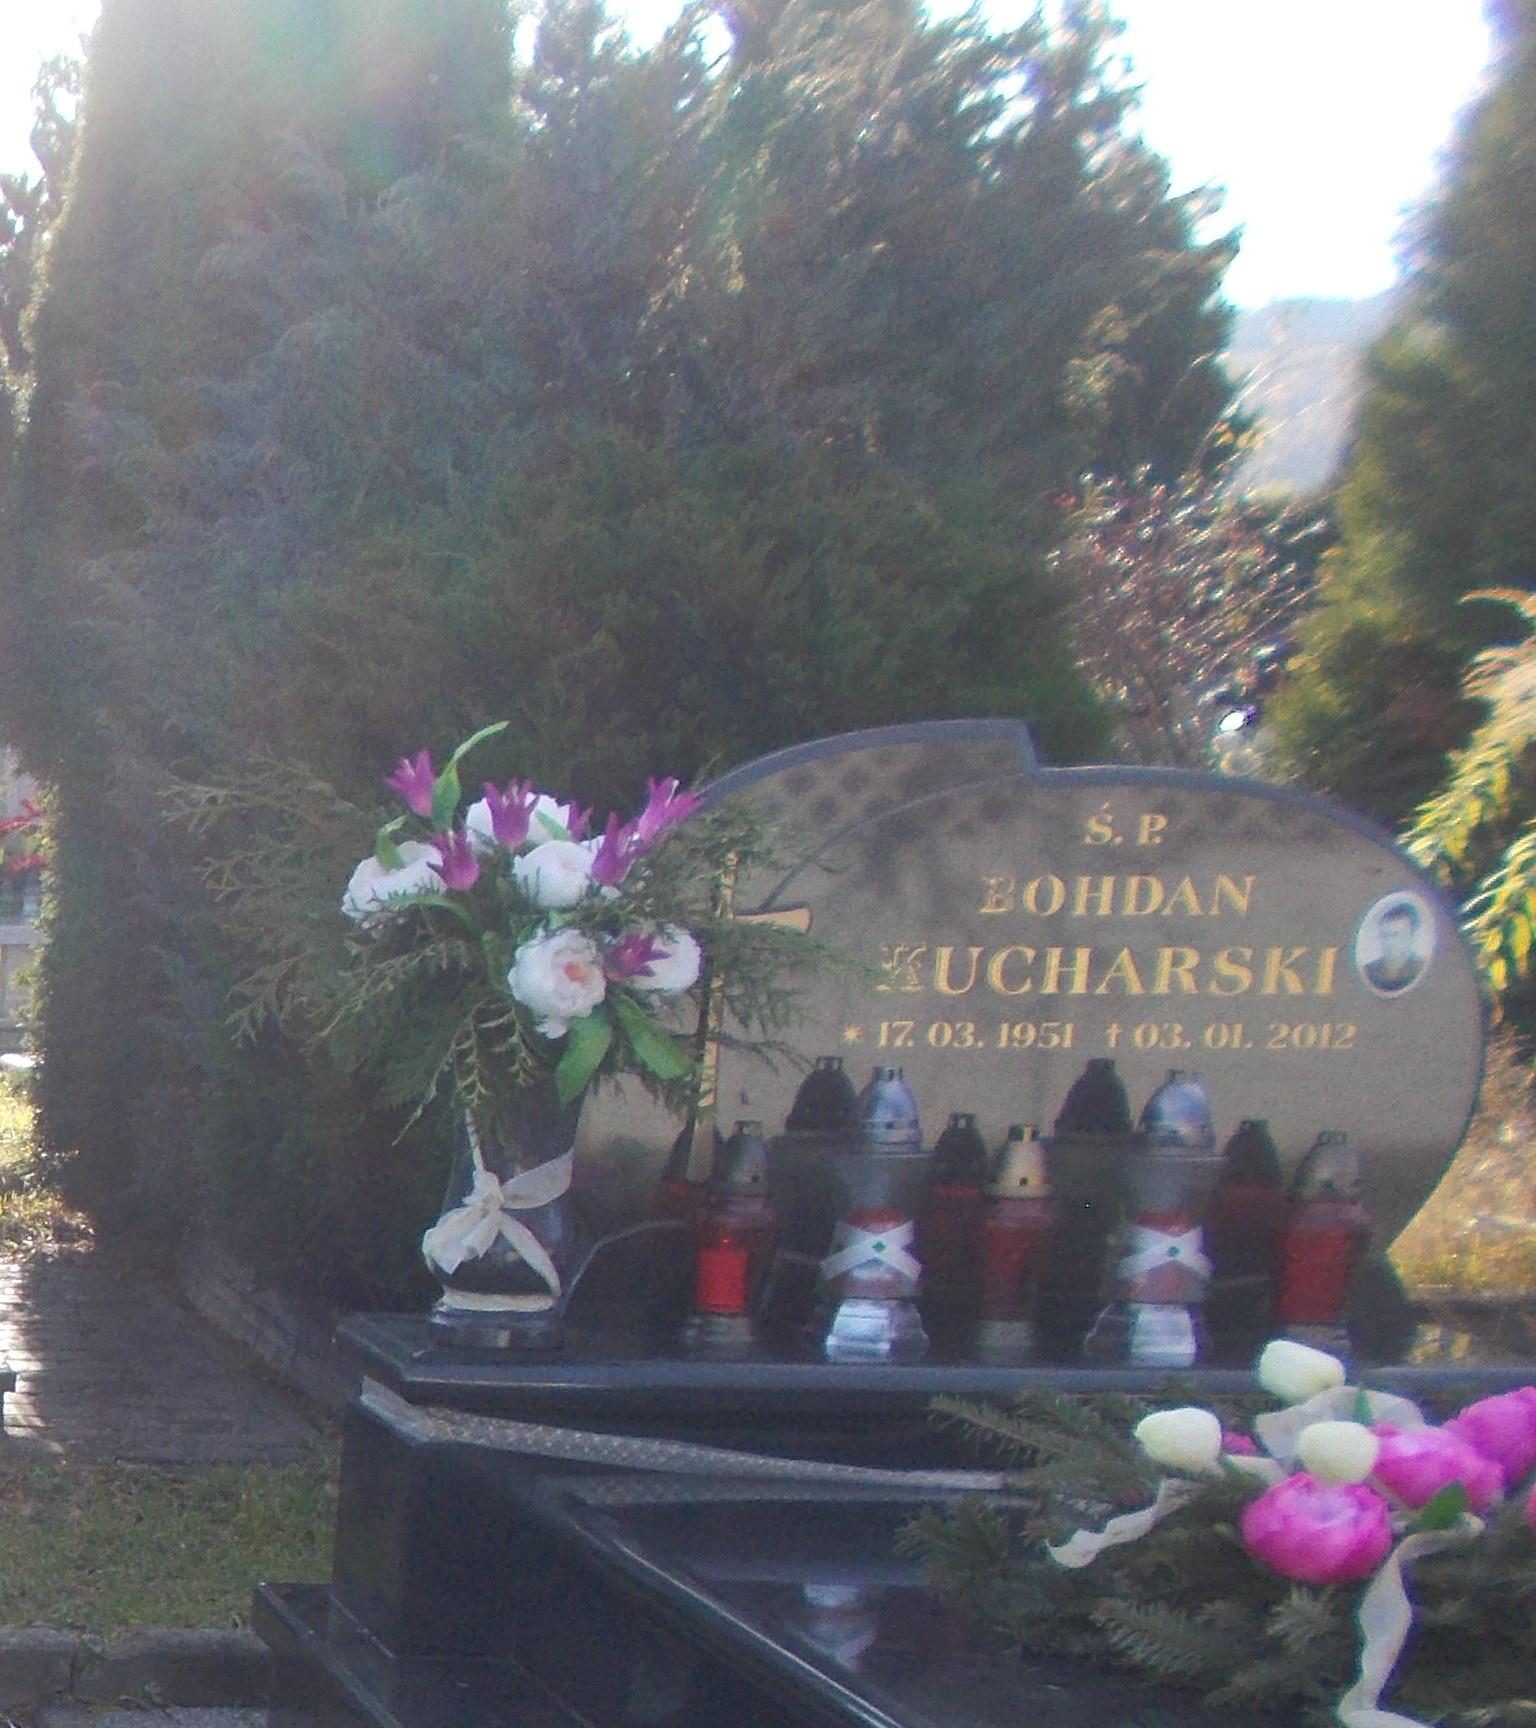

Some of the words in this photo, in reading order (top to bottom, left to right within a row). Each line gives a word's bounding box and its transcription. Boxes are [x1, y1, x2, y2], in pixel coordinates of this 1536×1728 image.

[979, 874, 1258, 916] BOHDAN
[875, 941, 1340, 996] KUCHARSKI
[927, 1020, 985, 1050] 03.
[998, 1020, 1076, 1050] 1951
[1131, 1021, 1191, 1051] 03.
[1203, 1021, 1254, 1051] 01.
[1266, 1021, 1358, 1051] 2012
